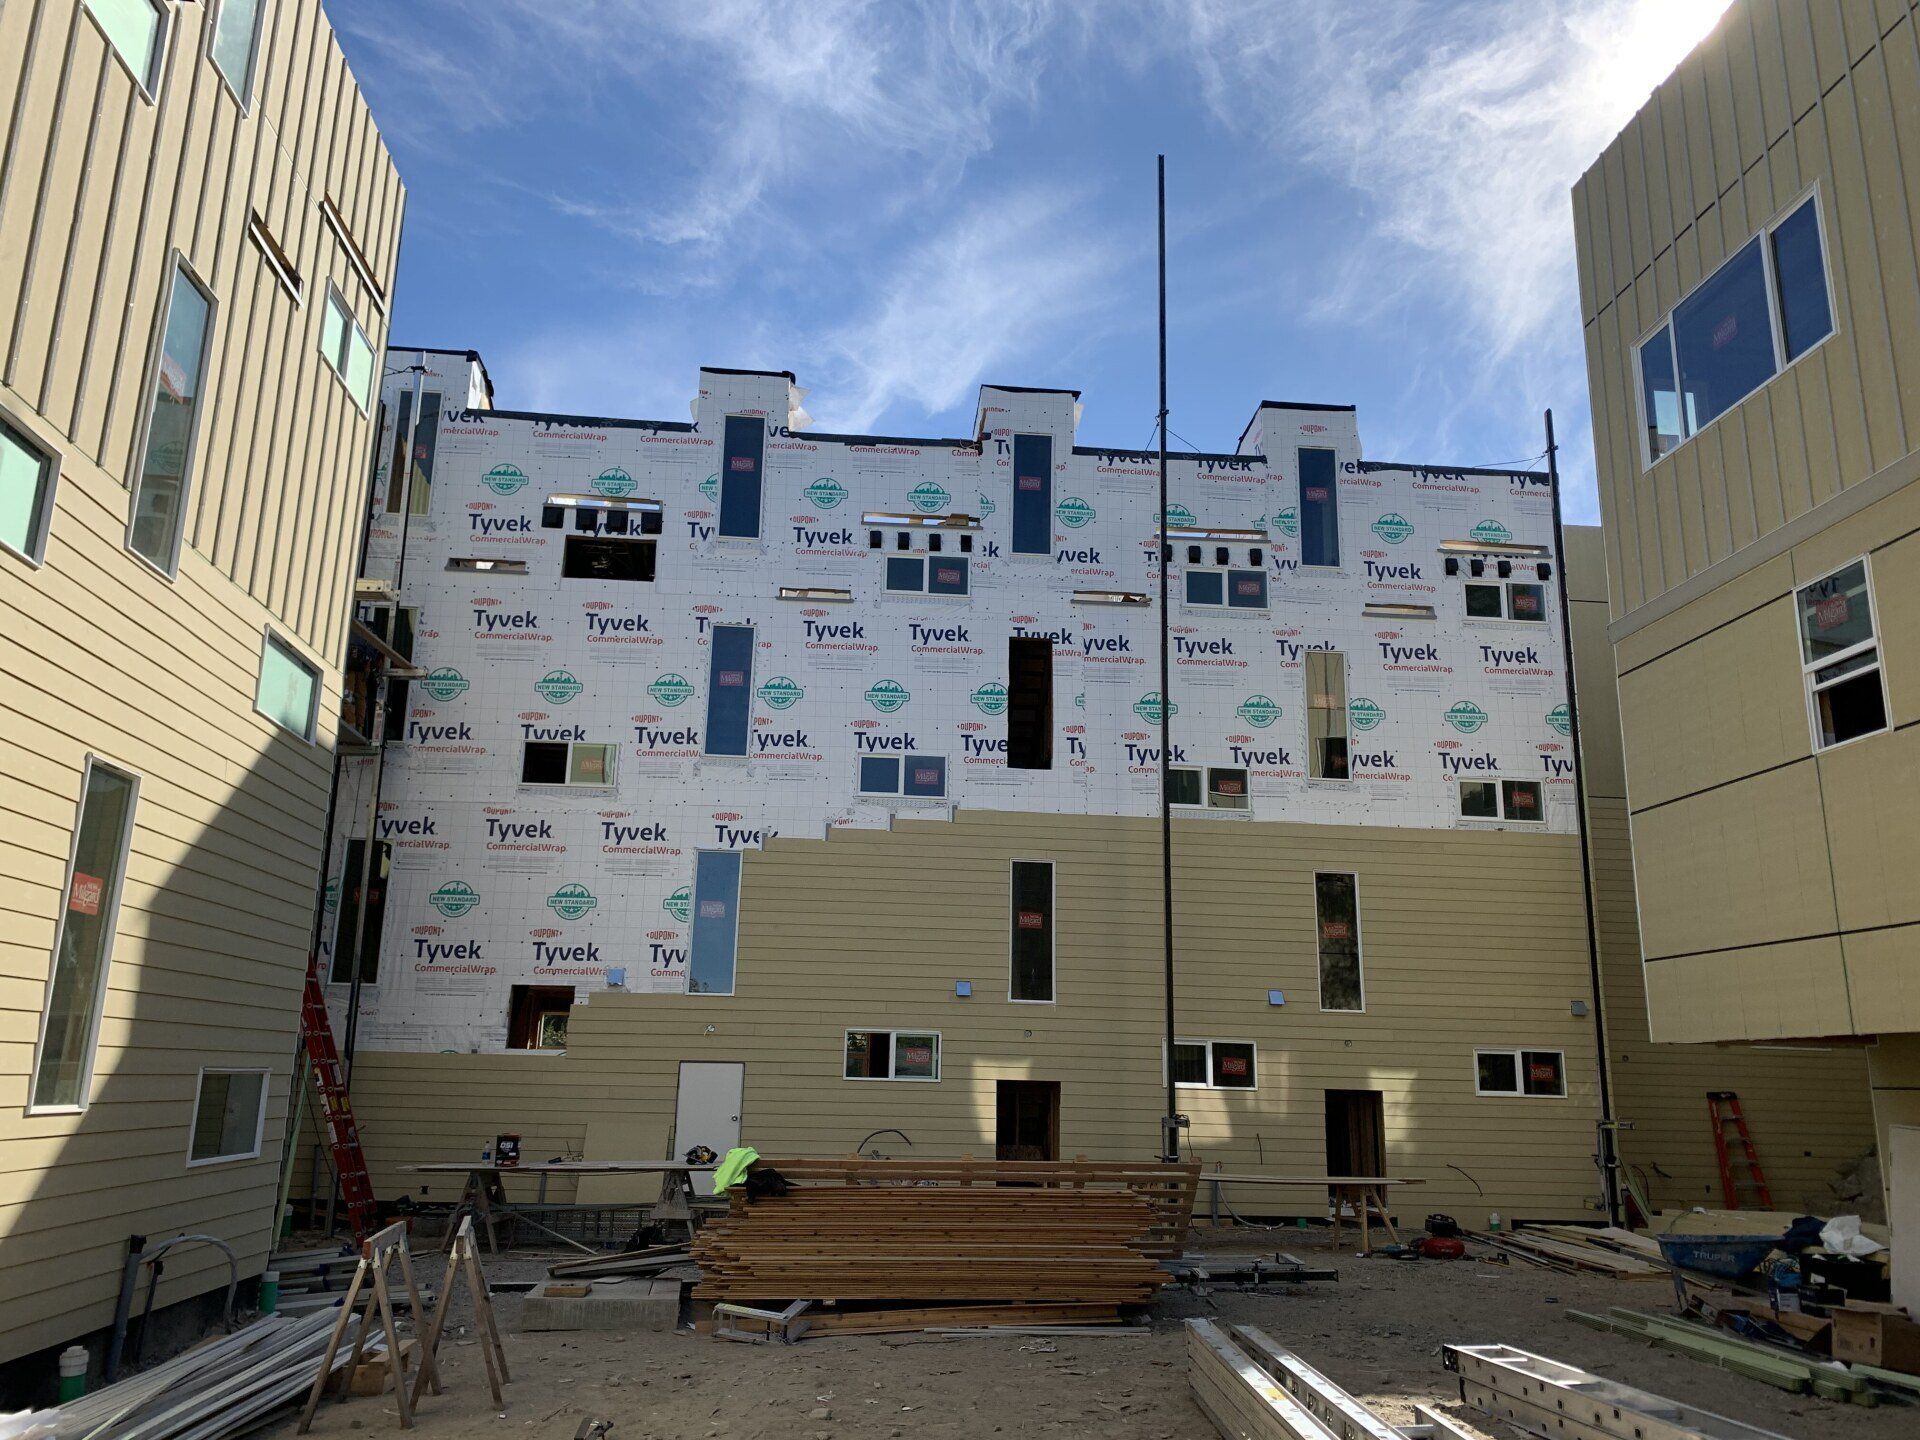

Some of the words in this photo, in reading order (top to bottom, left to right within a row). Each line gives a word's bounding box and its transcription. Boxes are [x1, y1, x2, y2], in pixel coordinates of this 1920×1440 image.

[441, 427, 499, 437] mercialWrap
[993, 428, 1010, 436] DUPO
[768, 442, 817, 451] ercialWrap
[1097, 466, 1161, 476] CommercialWra
[1340, 477, 1381, 487] ercialWrap
[1510, 489, 1551, 498] Commercia
[469, 513, 532, 535] Tyvek
[793, 527, 853, 547] Tyvek
[1143, 540, 1159, 548] DUPO
[1057, 548, 1101, 563] yvek
[1271, 544, 1286, 552] PONT
[1071, 568, 1115, 577] ercialWrap
[1364, 560, 1422, 581] Tyvek
[473, 609, 537, 631] Tyvek
[586, 612, 649, 635] Tyvek
[803, 620, 864, 642] Tyvek
[909, 624, 969, 645] Tyvek
[1084, 635, 1130, 655] yvek
[1173, 637, 1233, 657] Tyvek
[1379, 642, 1438, 663] Tyvek
[1084, 656, 1145, 665] mmercialWrap
[1480, 646, 1539, 667] Tyvek
[754, 717, 769, 725] PONT
[634, 727, 698, 749] Tyvek
[754, 730, 808, 751] yvek
[854, 731, 916, 752] Tyvek
[961, 734, 1008, 756] Tyve
[636, 749, 700, 758] CommercialW
[1230, 746, 1290, 767] Tyvek
[1352, 751, 1395, 771] yvek
[1438, 752, 1498, 774] Tyvek
[1540, 755, 1573, 776] Tyv
[1353, 773, 1411, 782] mmercialWrap
[377, 803, 396, 811] PONT
[486, 819, 552, 842] Tyvek
[602, 822, 667, 845] Tyvek
[715, 825, 759, 848] Tyve
[396, 840, 449, 850] ercialWrap
[414, 939, 482, 963] Tyvek
[532, 942, 600, 966] Tyvek
[650, 944, 687, 968] Tyv
[533, 966, 607, 976] CommercialWra
